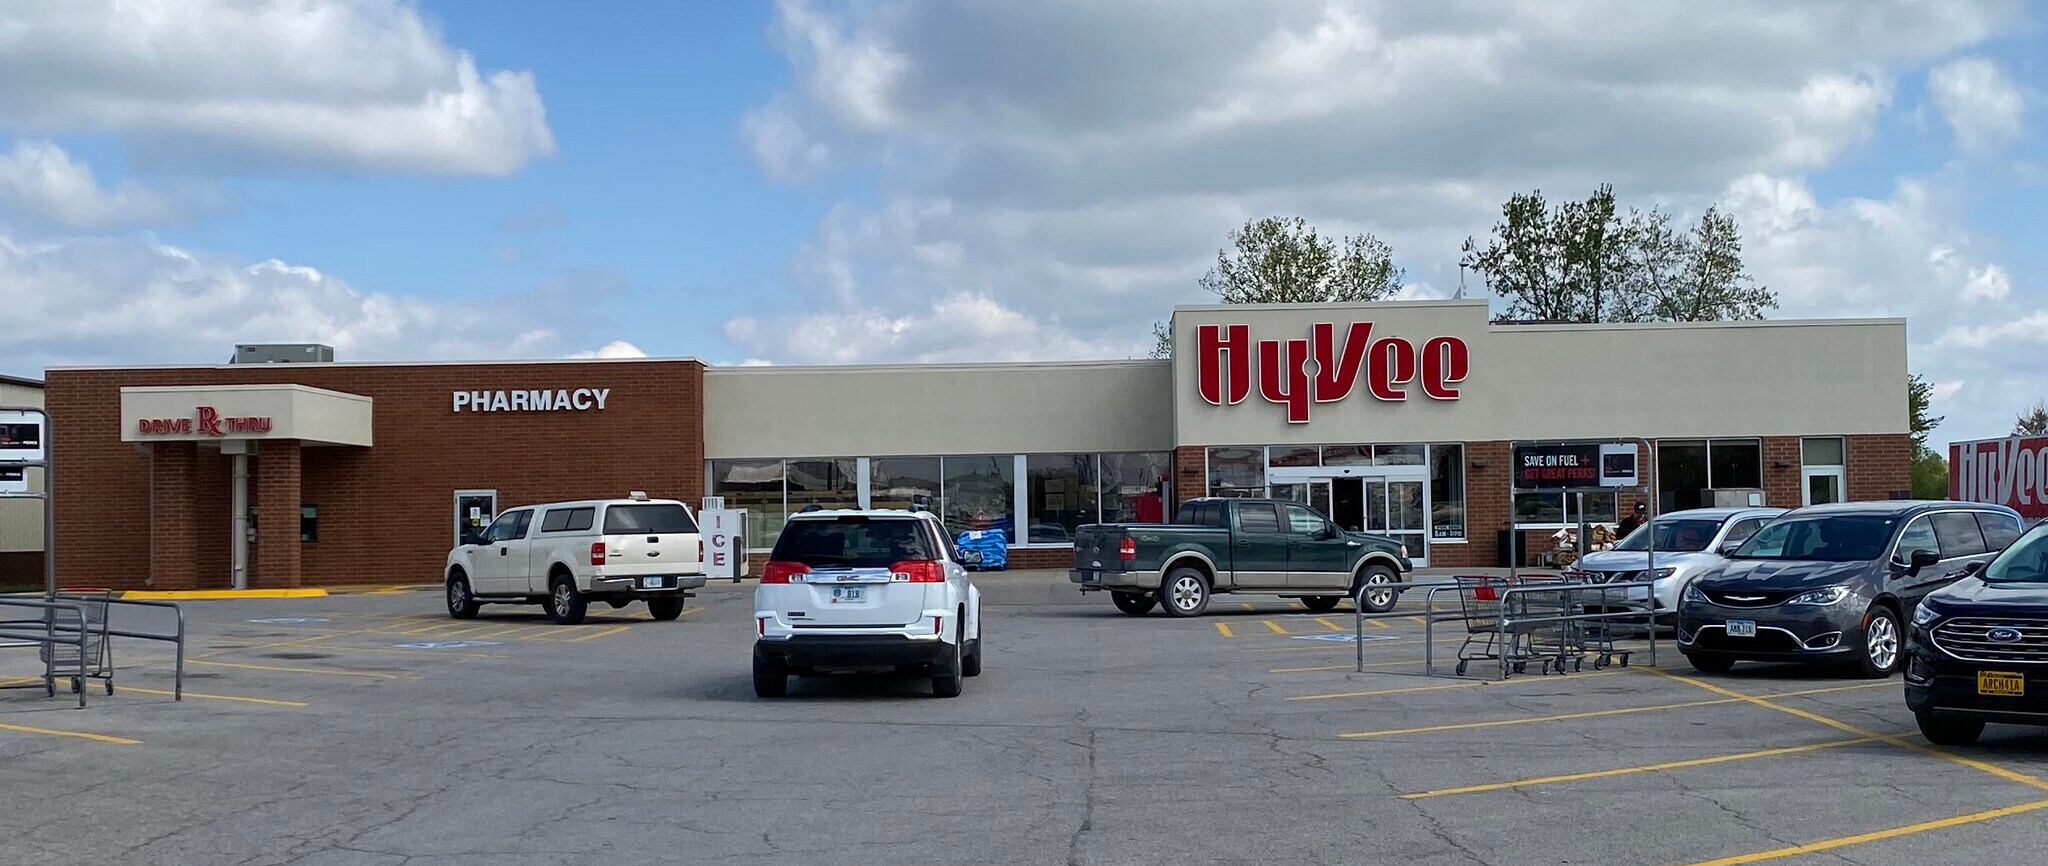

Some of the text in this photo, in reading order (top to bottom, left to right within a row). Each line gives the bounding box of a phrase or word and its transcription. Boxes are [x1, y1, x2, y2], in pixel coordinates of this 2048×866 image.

[1197, 321, 1470, 424] HyVee
[453, 388, 609, 412] PHARMACY
[139, 419, 192, 433] DRIVE
[225, 417, 272, 432] THRU
[1524, 455, 1544, 467] SAVE
[1546, 455, 1557, 466] ON
[1559, 454, 1578, 466] FUEL
[1525, 467, 1595, 480] GET GREAT PERKS!
[712, 515, 725, 566] ICE
